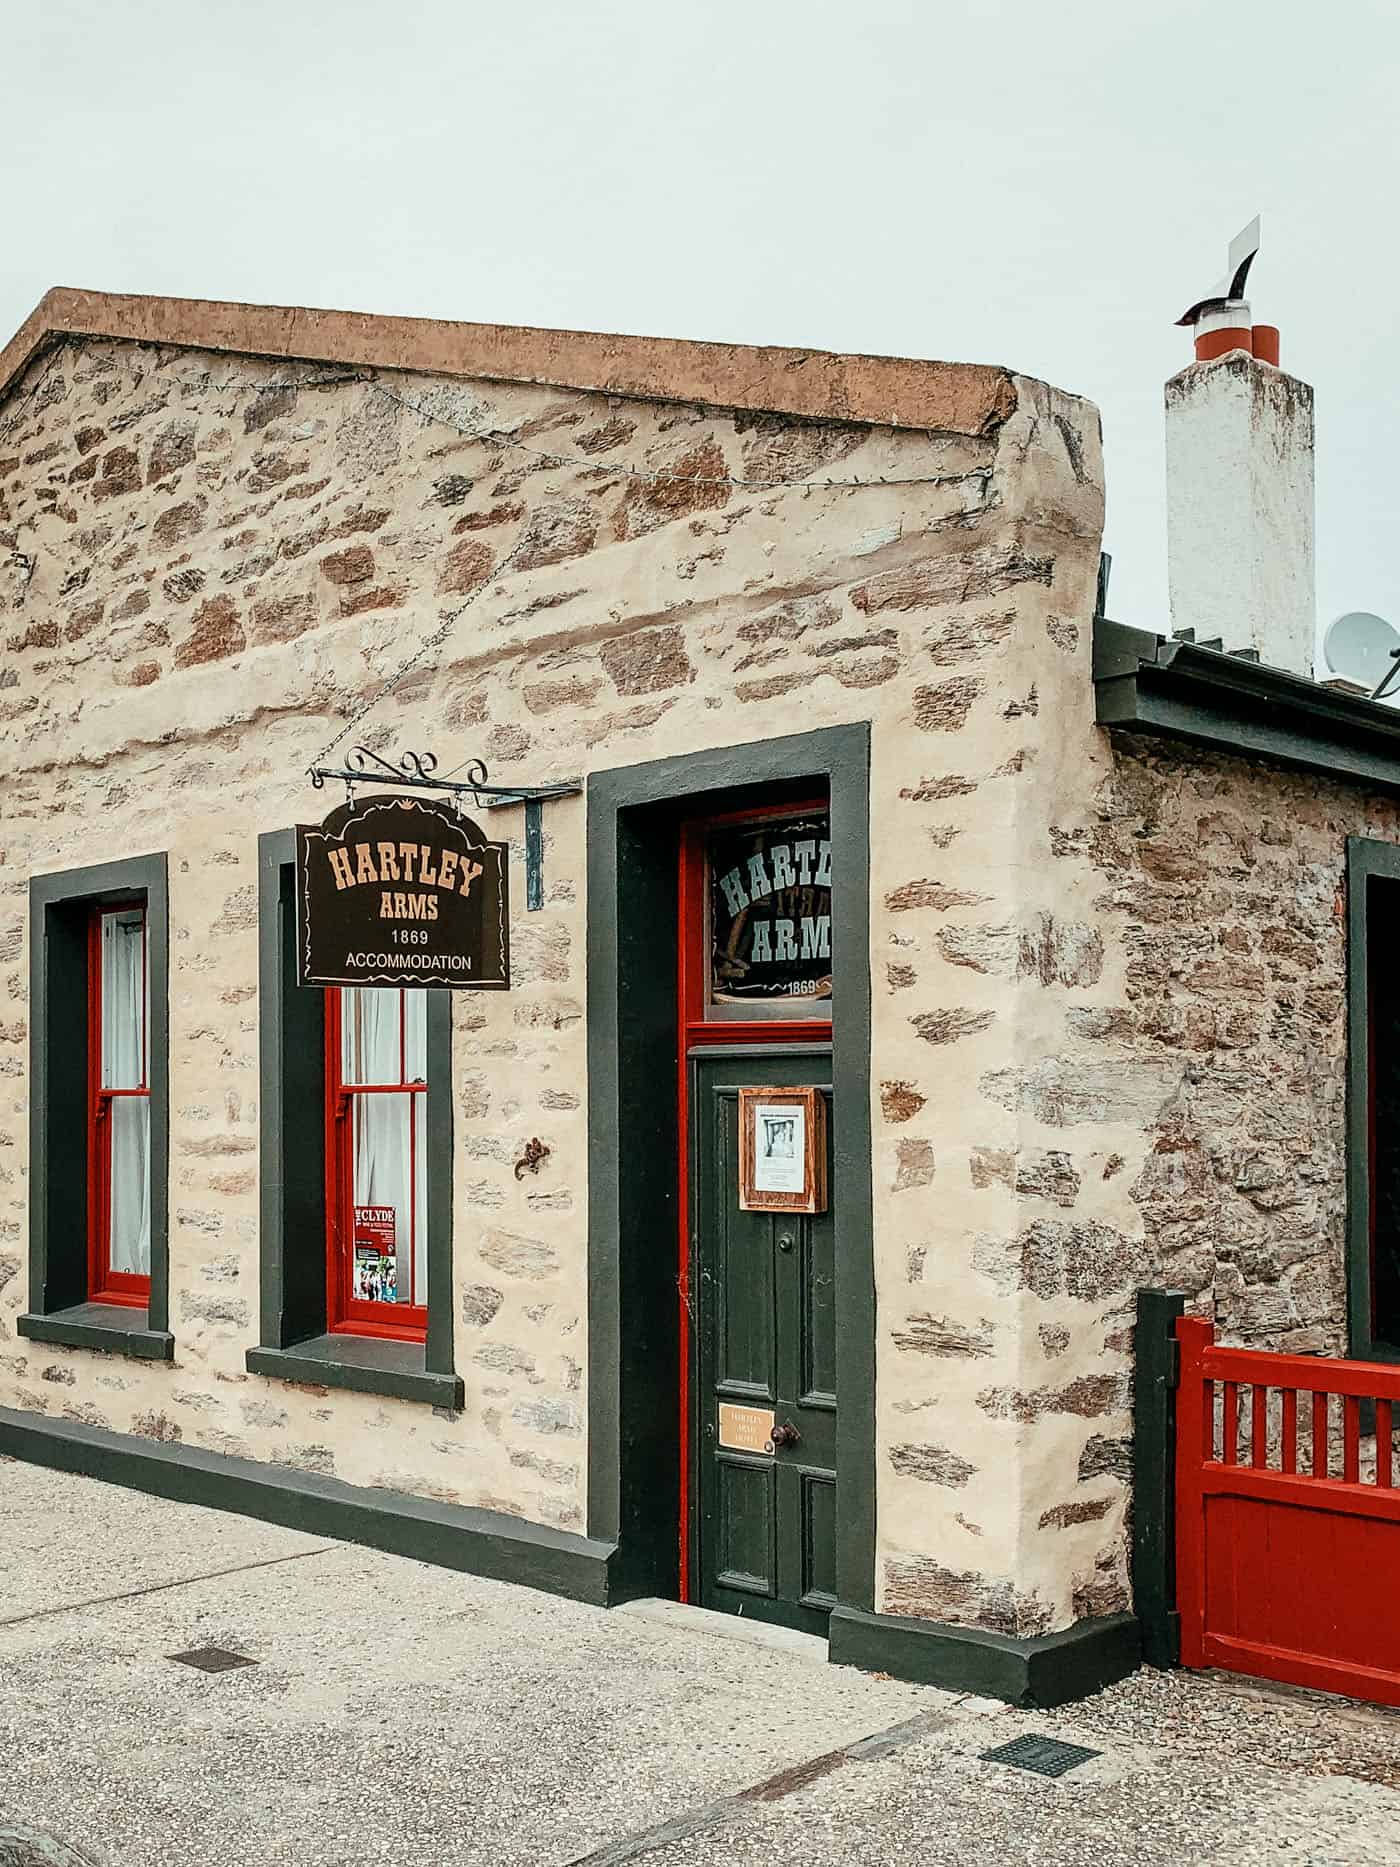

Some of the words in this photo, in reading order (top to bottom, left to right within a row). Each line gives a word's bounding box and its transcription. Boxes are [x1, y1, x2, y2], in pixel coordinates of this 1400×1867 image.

[327, 841, 484, 897] HARTLEY
[719, 839, 832, 918] HARTL
[379, 891, 439, 921] ARMS
[391, 929, 429, 945] 1869
[751, 915, 832, 963] ARM
[345, 952, 472, 970] ACCOMMODATION
[787, 980, 817, 995] 1869
[361, 1209, 394, 1222] CLYDE
